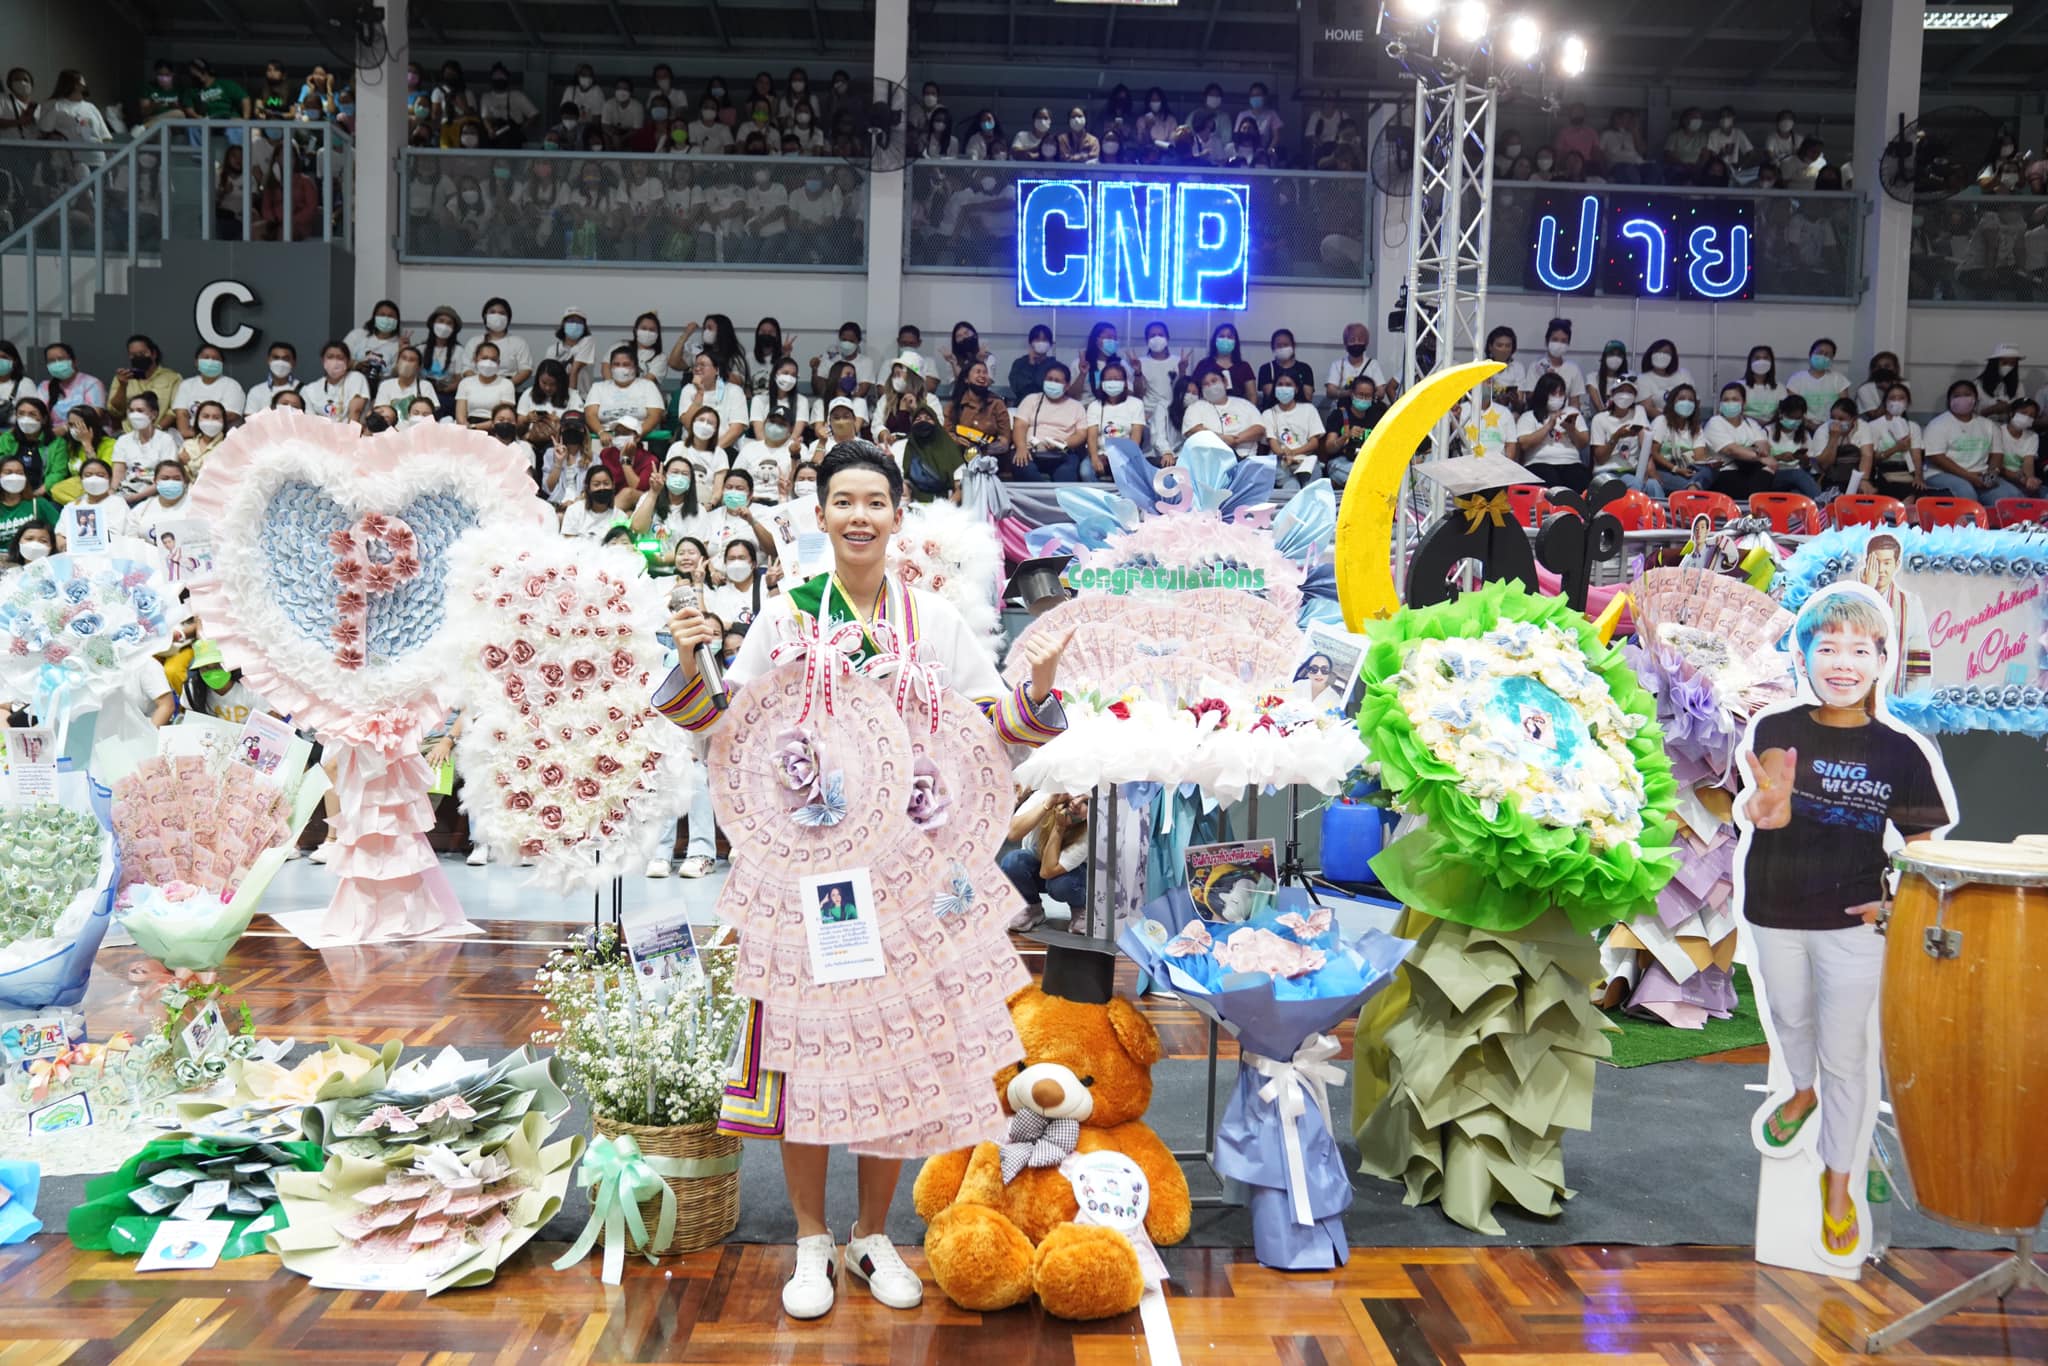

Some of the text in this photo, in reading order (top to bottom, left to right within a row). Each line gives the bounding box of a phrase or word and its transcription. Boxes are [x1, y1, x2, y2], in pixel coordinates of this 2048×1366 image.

[1325, 29, 1364, 41] HOME
[1022, 182, 1245, 305] CNP
[1536, 195, 1748, 298] ปาย
[195, 280, 255, 349] C
[1068, 562, 1265, 595] Congratulations
[1812, 759, 1868, 780] SING
[1821, 777, 1892, 801] MUSIC
